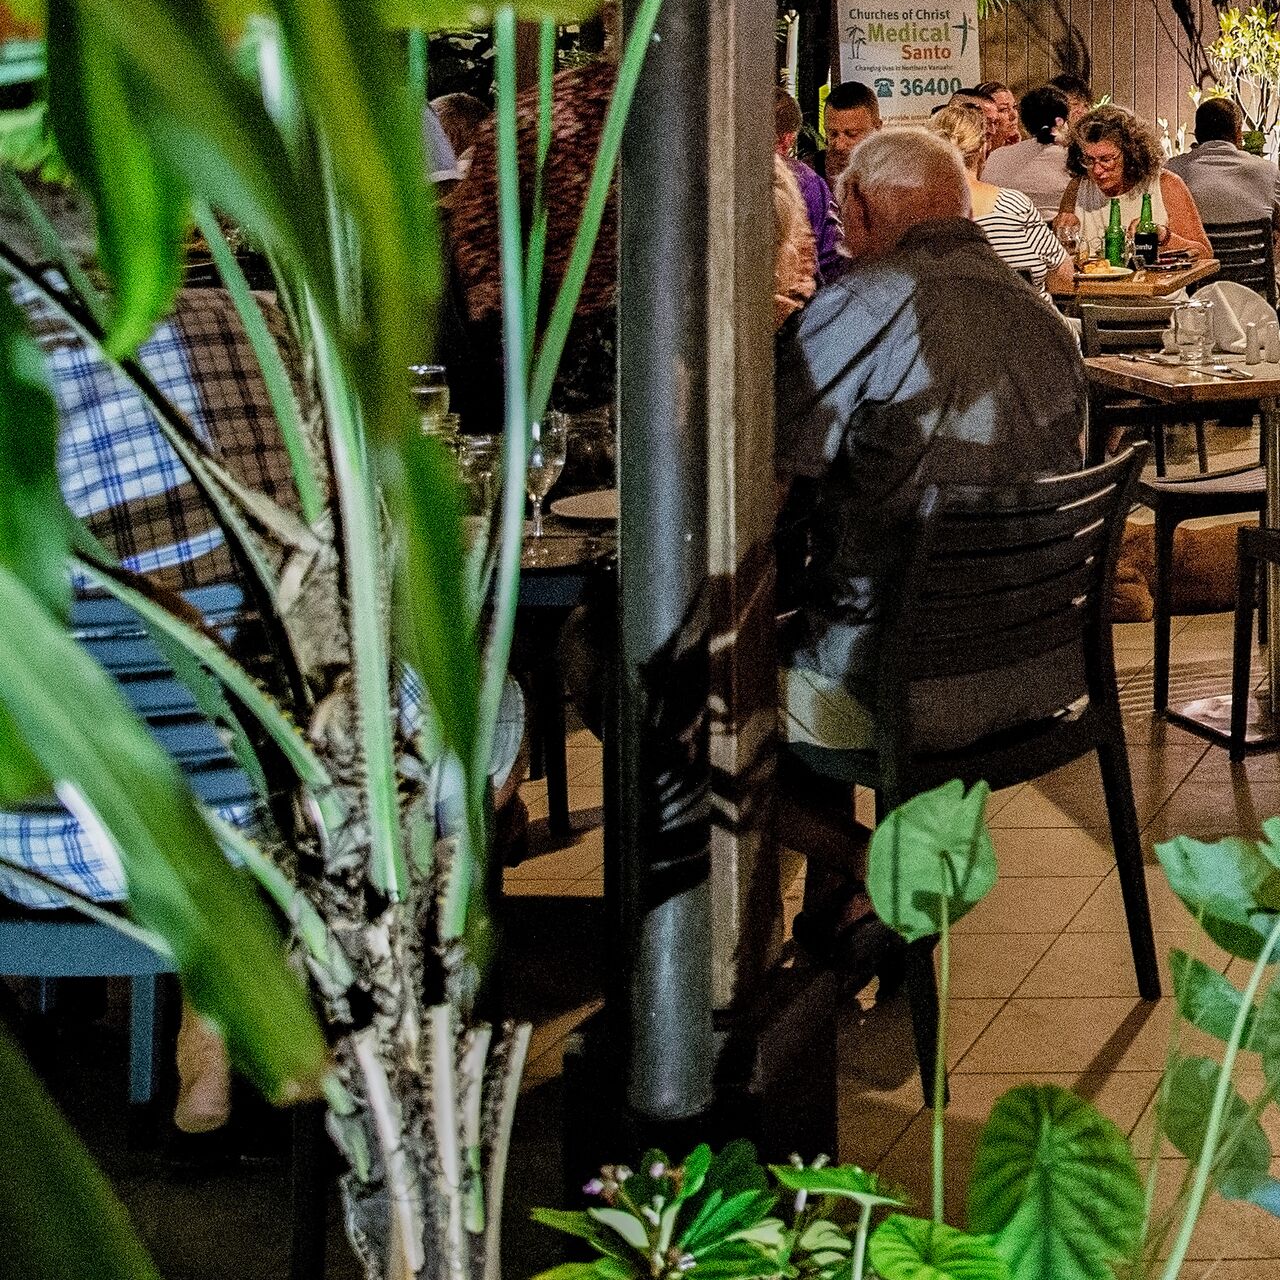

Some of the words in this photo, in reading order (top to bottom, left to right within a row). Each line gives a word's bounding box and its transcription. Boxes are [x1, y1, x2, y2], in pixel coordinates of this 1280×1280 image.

[849, 8, 899, 20] Churches
[902, 9, 914, 20] of
[916, 9, 951, 20] Christ
[868, 22, 951, 42] Medical
[901, 44, 952, 60] Santo
[900, 78, 962, 96] 36400
